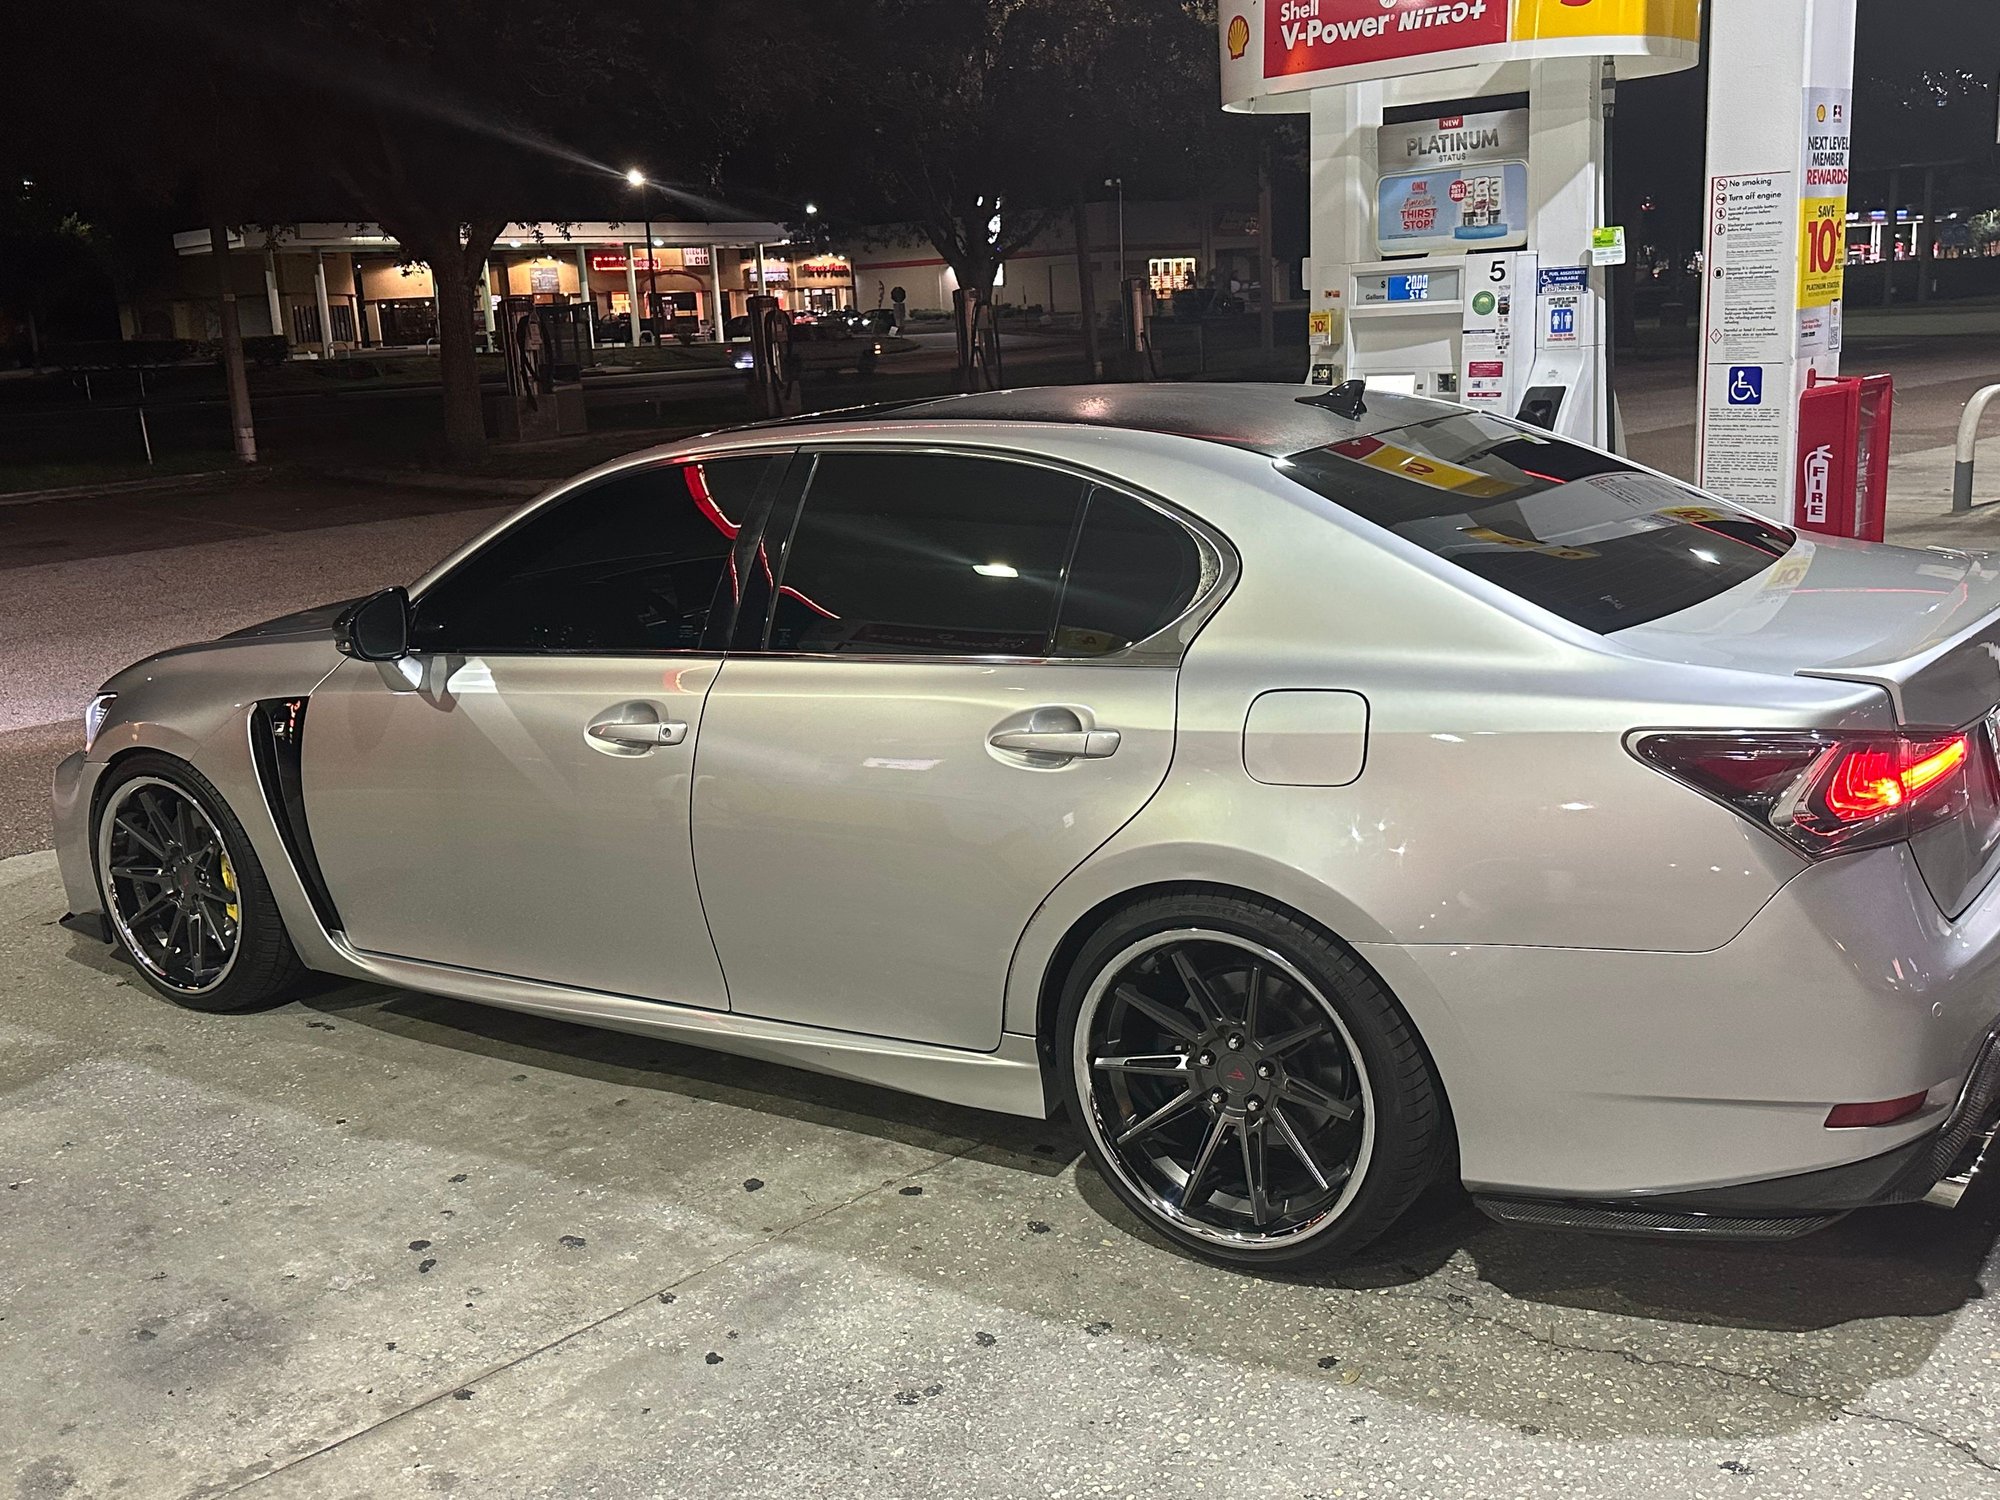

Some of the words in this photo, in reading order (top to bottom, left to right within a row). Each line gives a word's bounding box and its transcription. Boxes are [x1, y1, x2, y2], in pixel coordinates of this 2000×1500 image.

[1280, 0, 1318, 22] Shell
[1281, 14, 1390, 50] V-Power
[1443, 119, 1460, 127] NEW
[1406, 128, 1499, 156] PLATINUM
[1808, 136, 1828, 150] NEXT
[1830, 136, 1848, 150] LEVEL
[1439, 153, 1466, 162] STATUS
[1812, 153, 1844, 166] MEMBER
[1742, 177, 1771, 186] smoking
[1807, 169, 1847, 185] REWARDS
[1757, 191, 1781, 200] engine
[1401, 208, 1436, 219] THIRST
[1818, 205, 1834, 217] SAVE
[1404, 220, 1433, 229] STOP!
[1490, 261, 1506, 282] 5
[1811, 466, 1824, 515] FIRE
